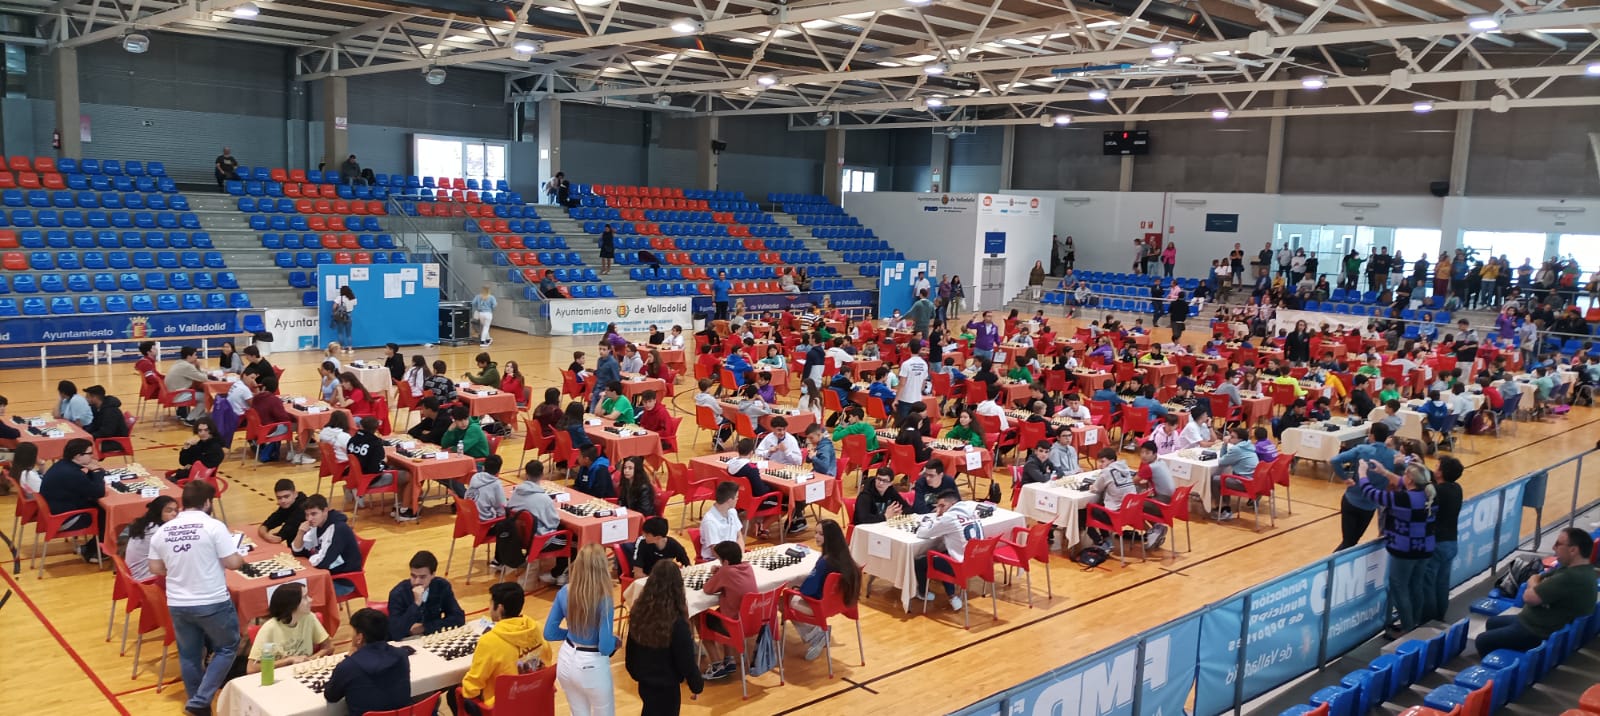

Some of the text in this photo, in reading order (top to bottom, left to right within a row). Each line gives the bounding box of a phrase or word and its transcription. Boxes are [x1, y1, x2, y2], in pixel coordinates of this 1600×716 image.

[555, 303, 687, 319] Ayuntamiento de Valladolid
[42, 322, 227, 341] Ayuntamiento de Valladolid
[572, 321, 609, 334] FMD
[173, 543, 192, 553] CAP
